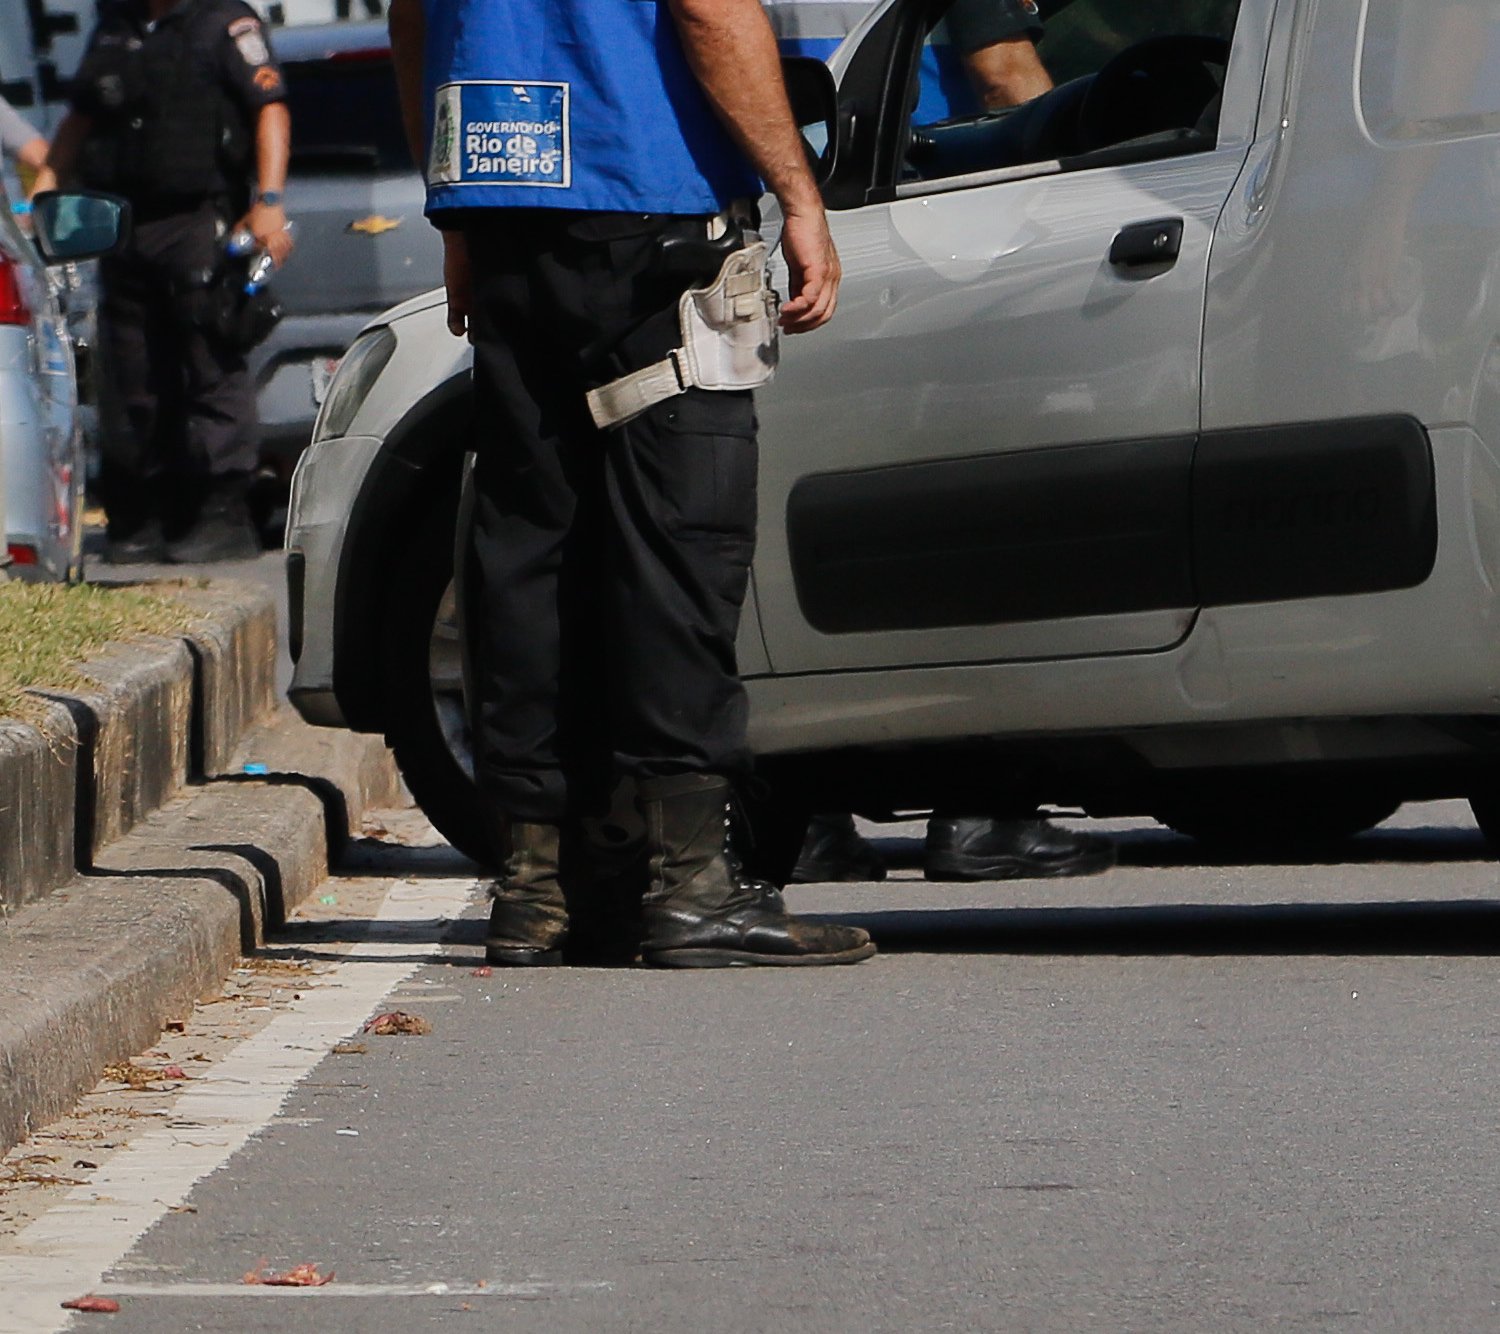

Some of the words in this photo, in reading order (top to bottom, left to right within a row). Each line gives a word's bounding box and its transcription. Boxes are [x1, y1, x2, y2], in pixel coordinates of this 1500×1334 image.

[466, 122, 530, 133] GOVERNO
[466, 134, 503, 154] Rio
[506, 134, 537, 155] de
[467, 154, 555, 174] Janeiro
